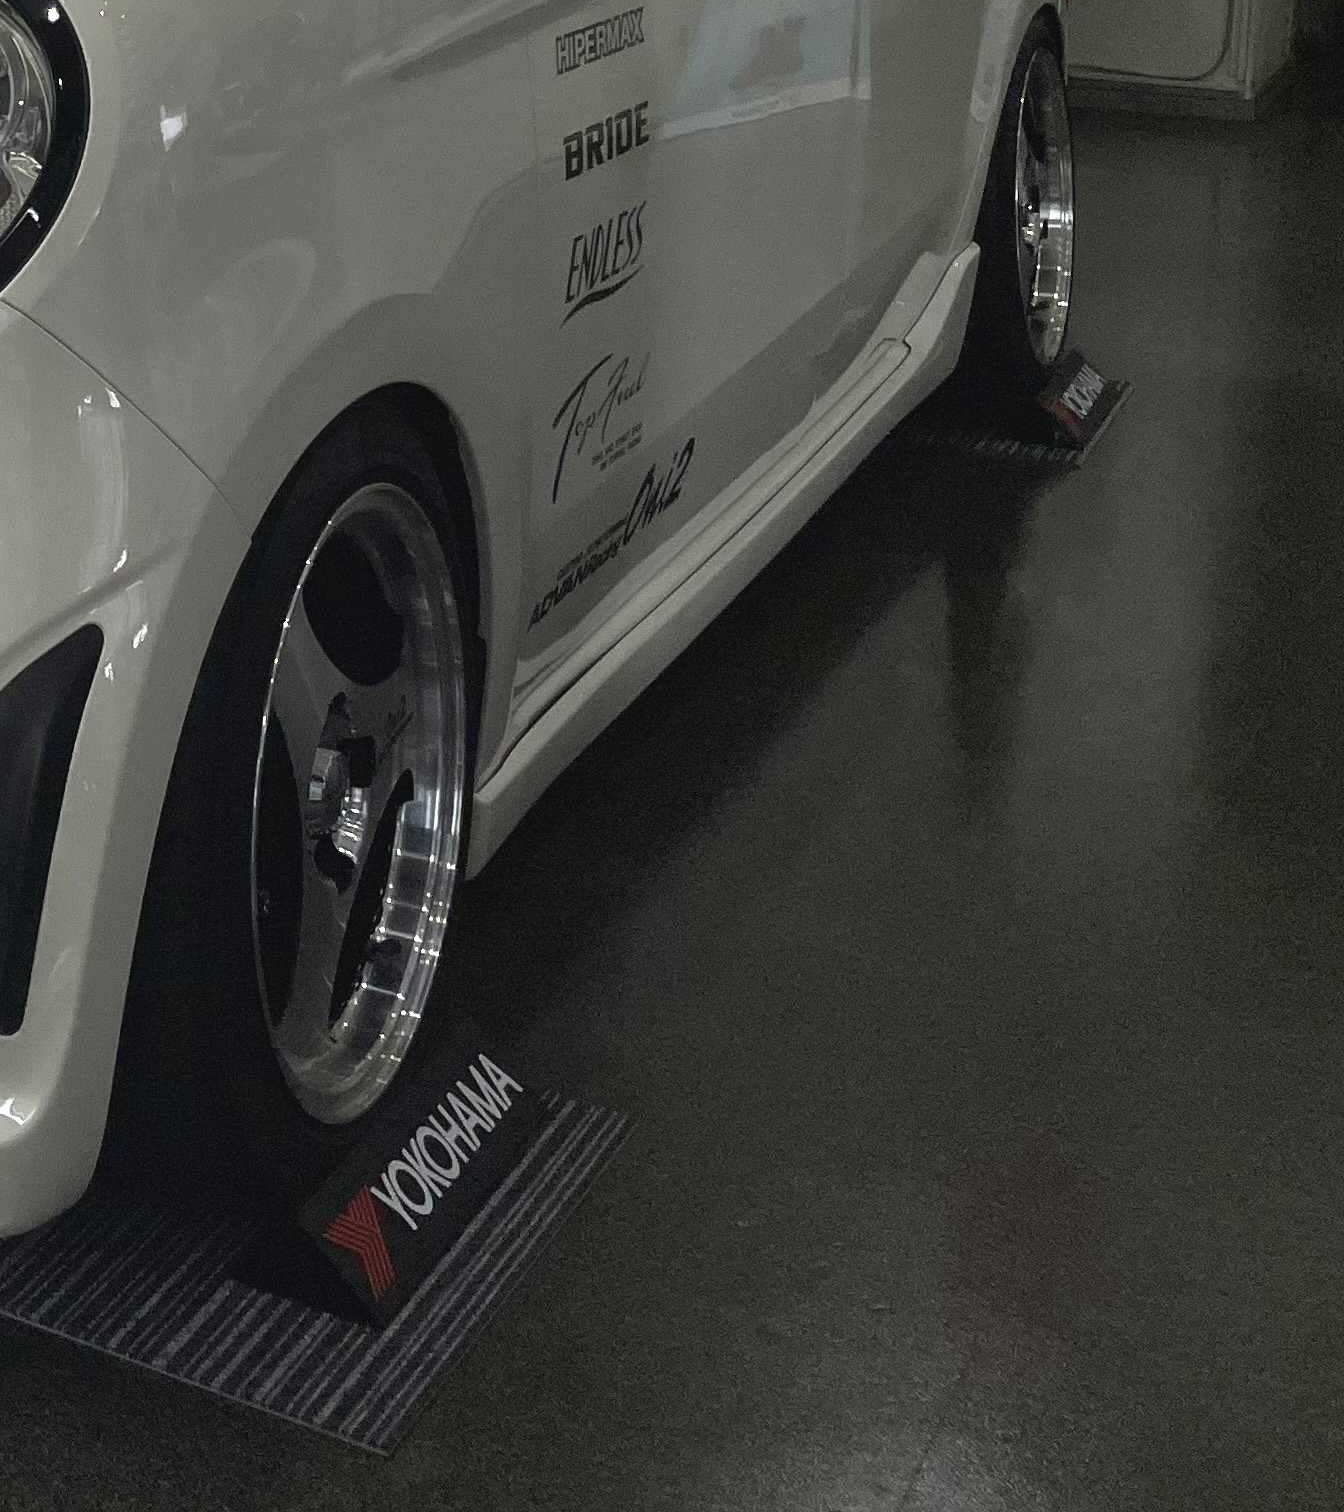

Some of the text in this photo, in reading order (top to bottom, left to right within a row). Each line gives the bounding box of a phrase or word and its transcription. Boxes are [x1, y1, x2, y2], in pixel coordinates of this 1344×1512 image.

[555, 6, 645, 76] HIPERMAX
[562, 100, 650, 182] BRIDE
[564, 200, 647, 305] ENDLESS
[370, 1053, 524, 1231] YOKOHAMA
